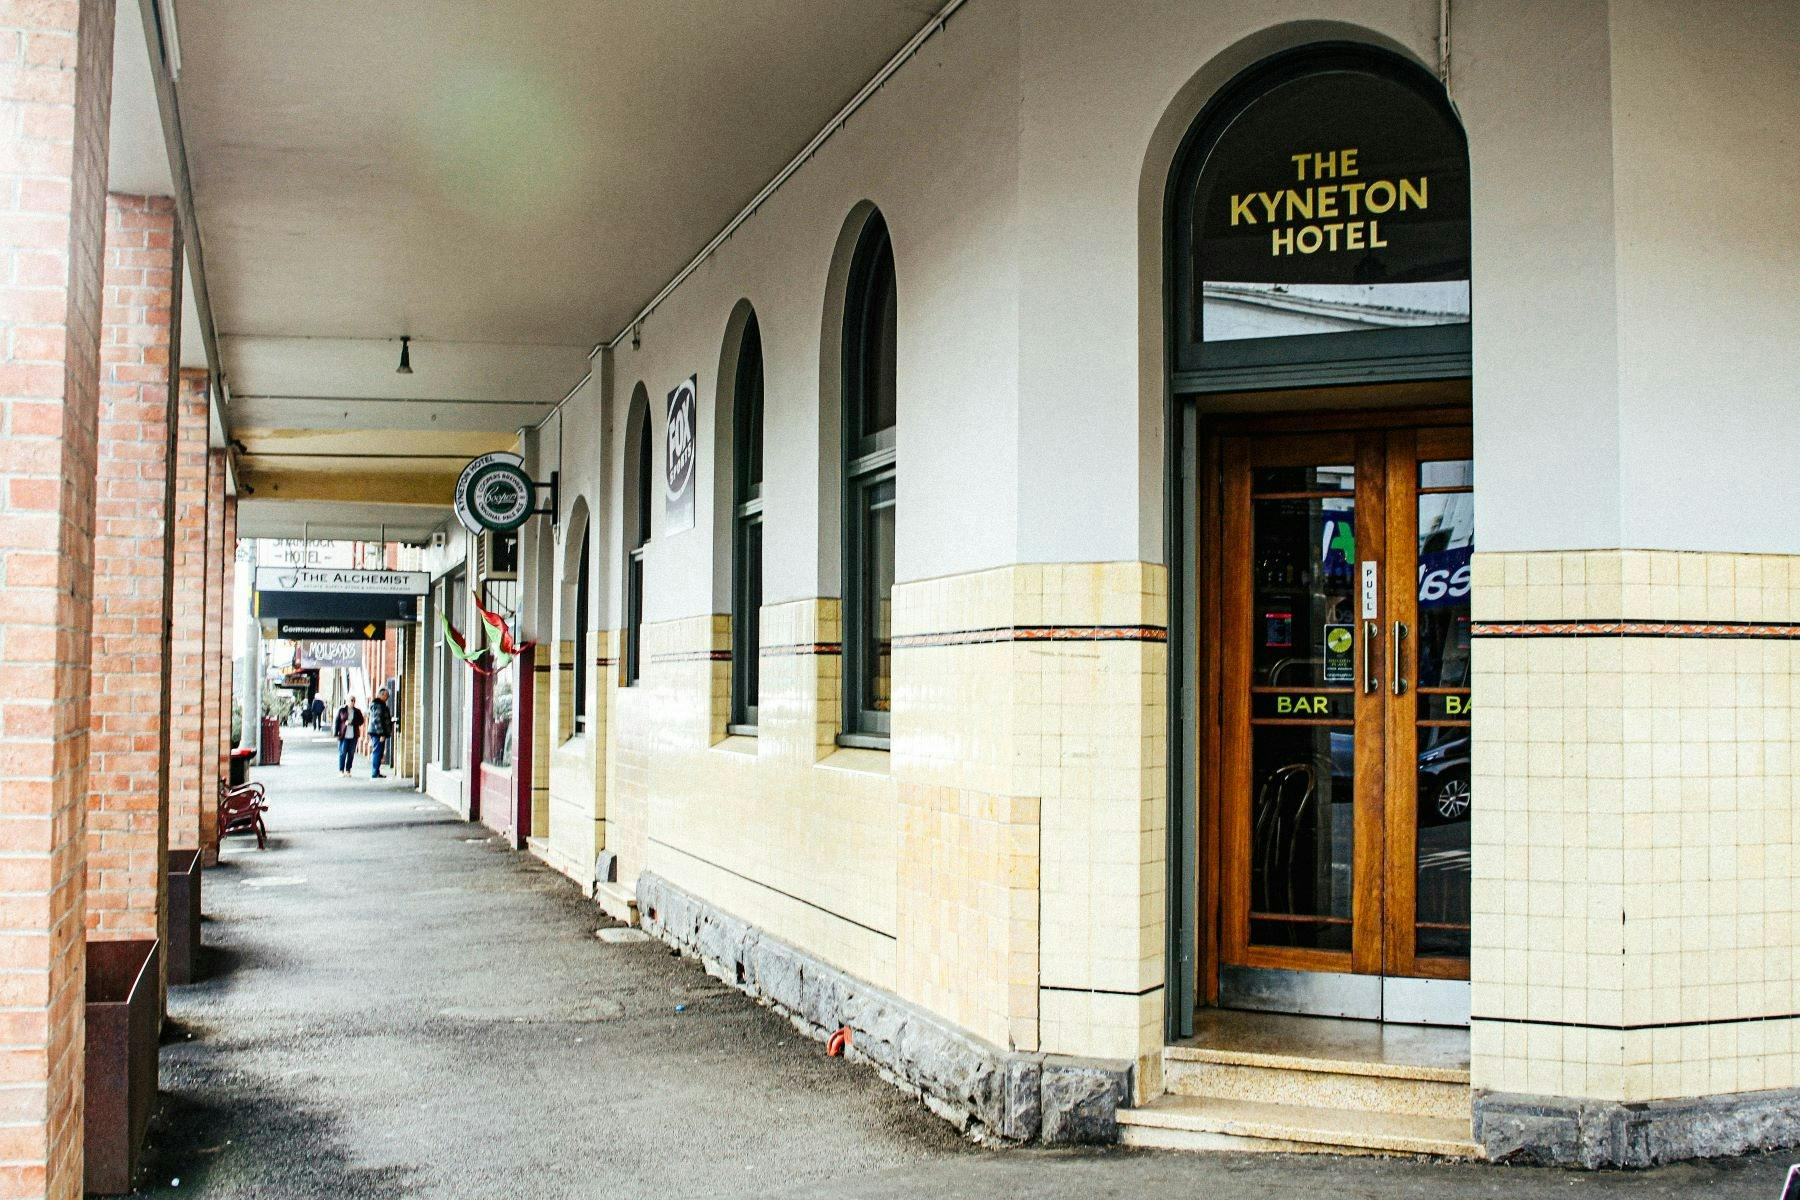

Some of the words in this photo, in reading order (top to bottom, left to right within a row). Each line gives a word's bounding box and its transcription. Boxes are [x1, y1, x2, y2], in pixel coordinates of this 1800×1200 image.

[1291, 148, 1359, 182] THE
[1230, 176, 1428, 227] KYNETON
[1271, 220, 1388, 257] HOTEL
[669, 393, 692, 471] FOX
[457, 472, 471, 511] KYNETON
[469, 454, 495, 472] HOTEL
[669, 441, 692, 486] SPORTS
[284, 550, 322, 564] HOTEL
[301, 572, 328, 584] THE
[333, 572, 411, 585] ALCHEMIST
[1364, 568, 1374, 611] PULL
[1276, 696, 1329, 714] BAR
